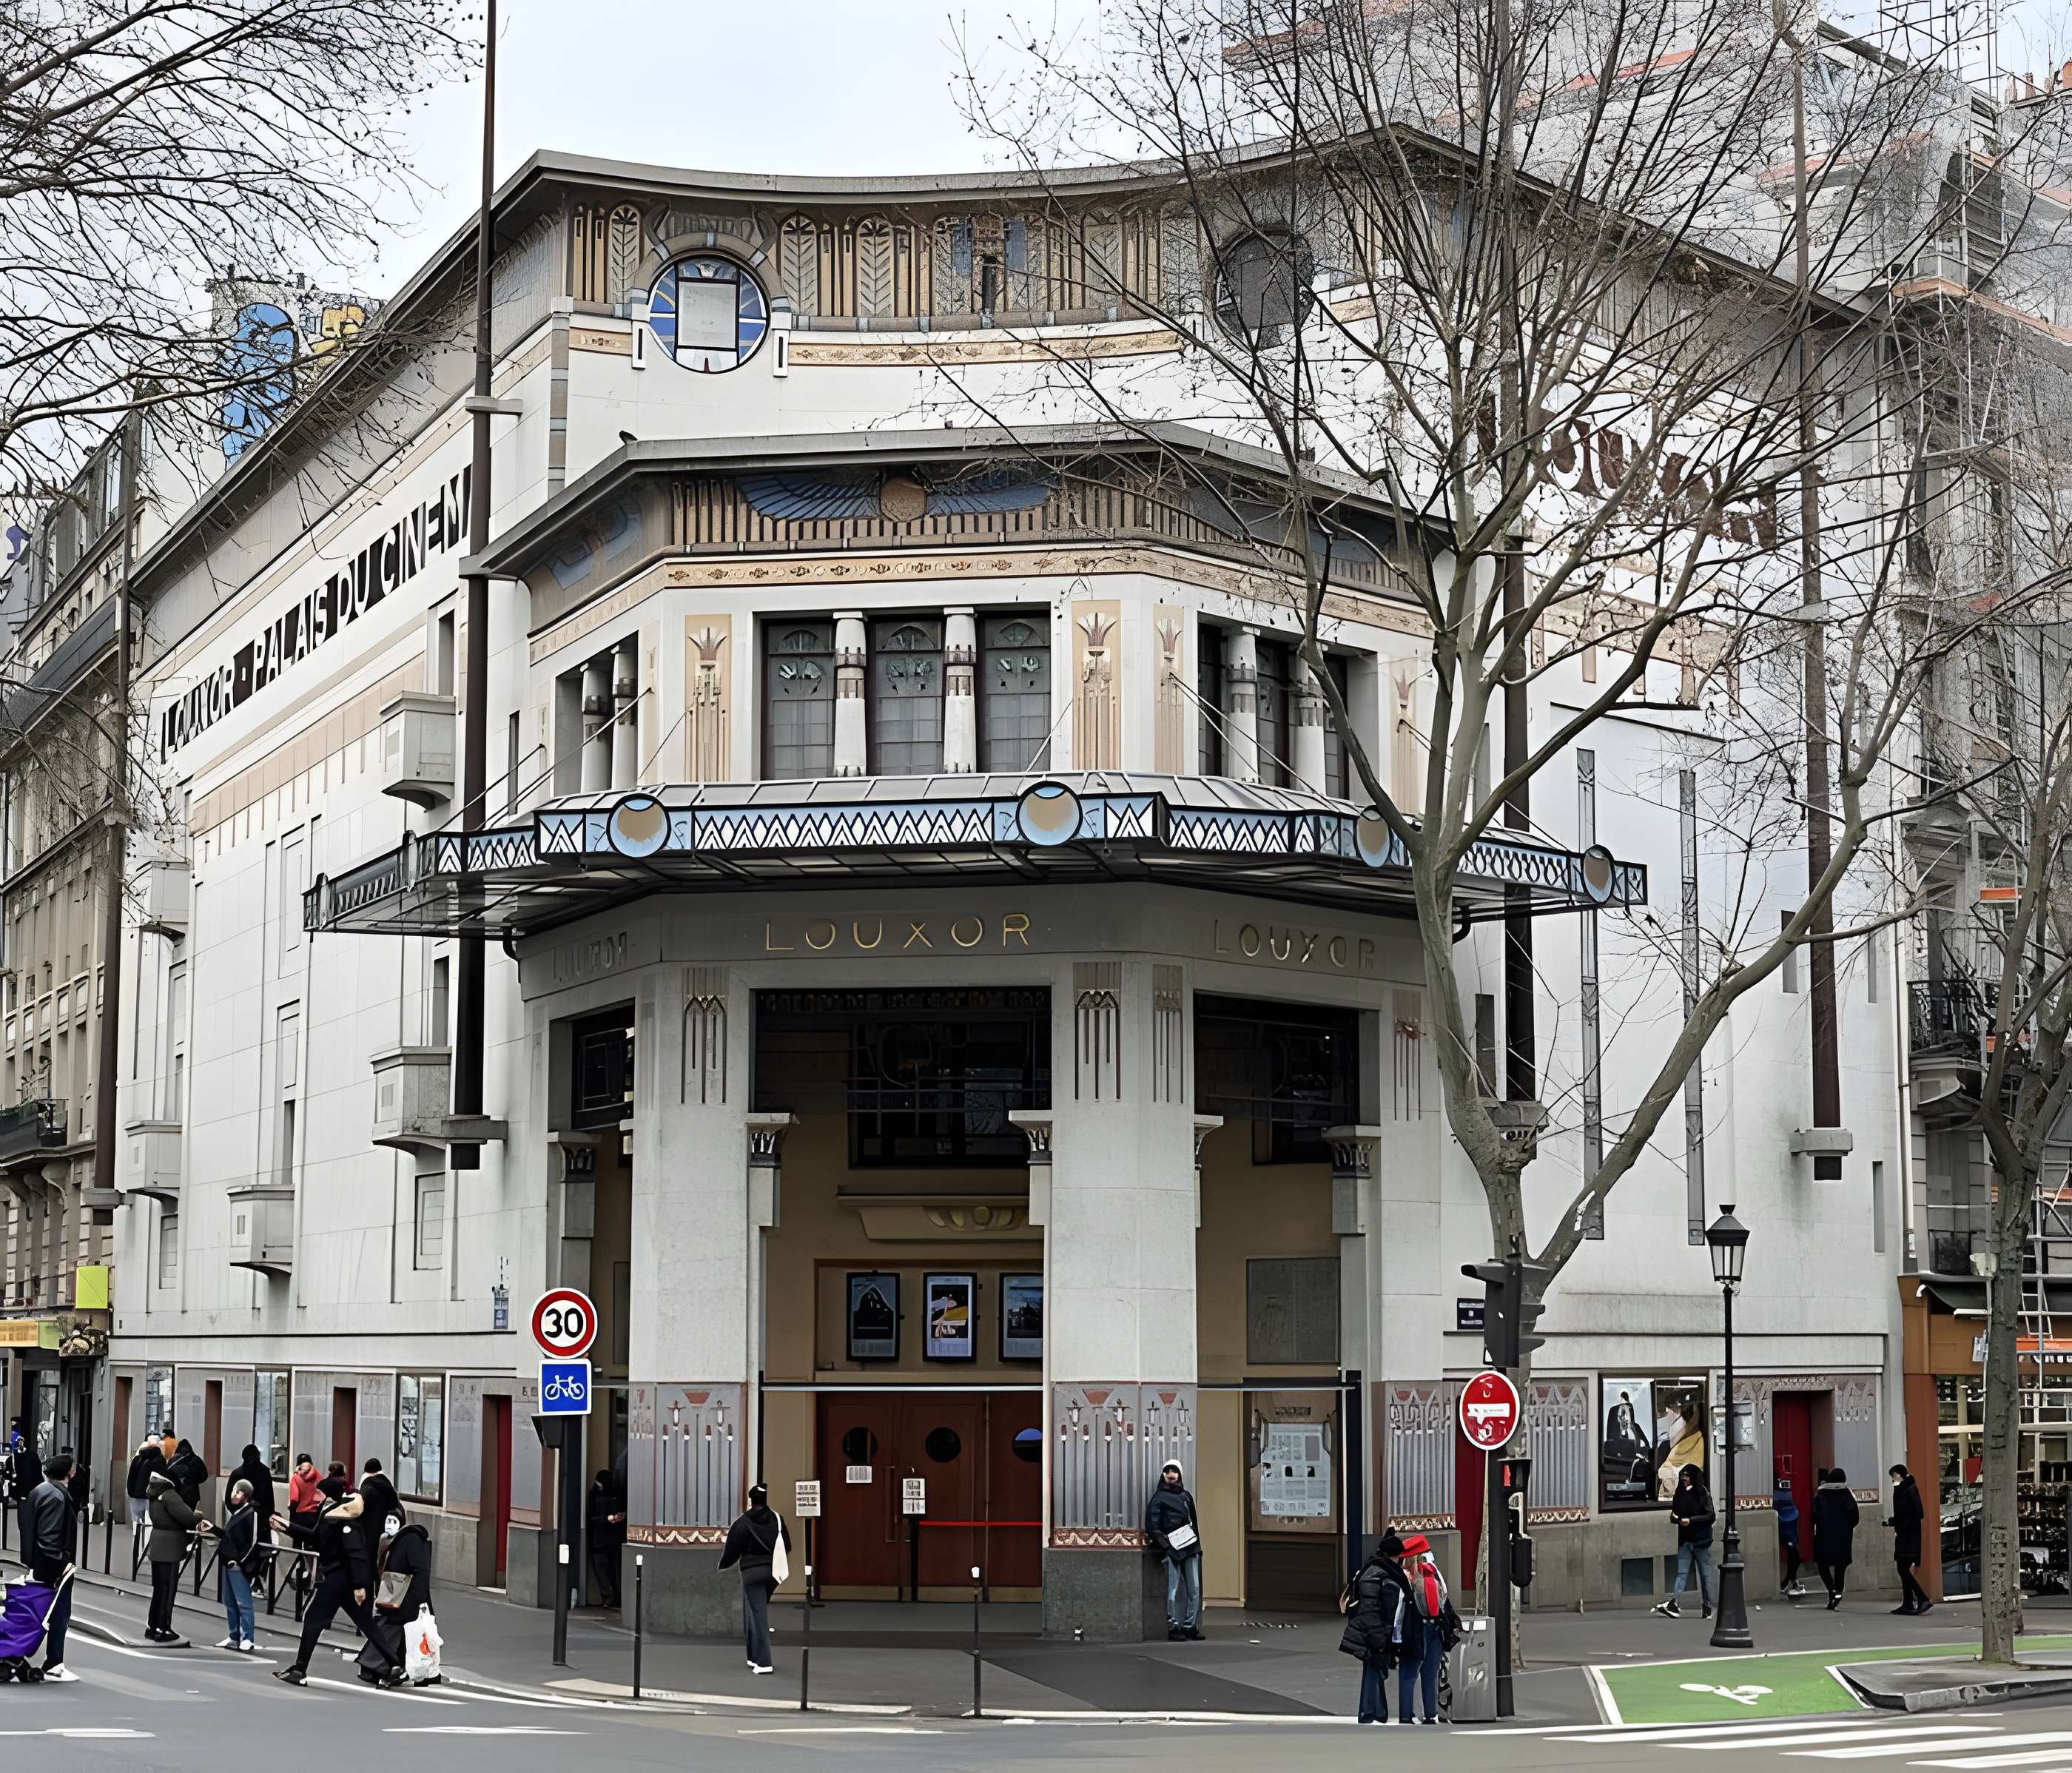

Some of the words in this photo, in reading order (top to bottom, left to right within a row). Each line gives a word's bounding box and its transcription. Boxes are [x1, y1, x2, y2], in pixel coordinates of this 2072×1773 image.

[253, 581, 328, 696] PALAIS
[337, 546, 371, 632] DU
[765, 912, 1031, 951] LOUXOR
[1214, 918, 1376, 972] LOUXOR
[544, 1308, 584, 1339] 30
